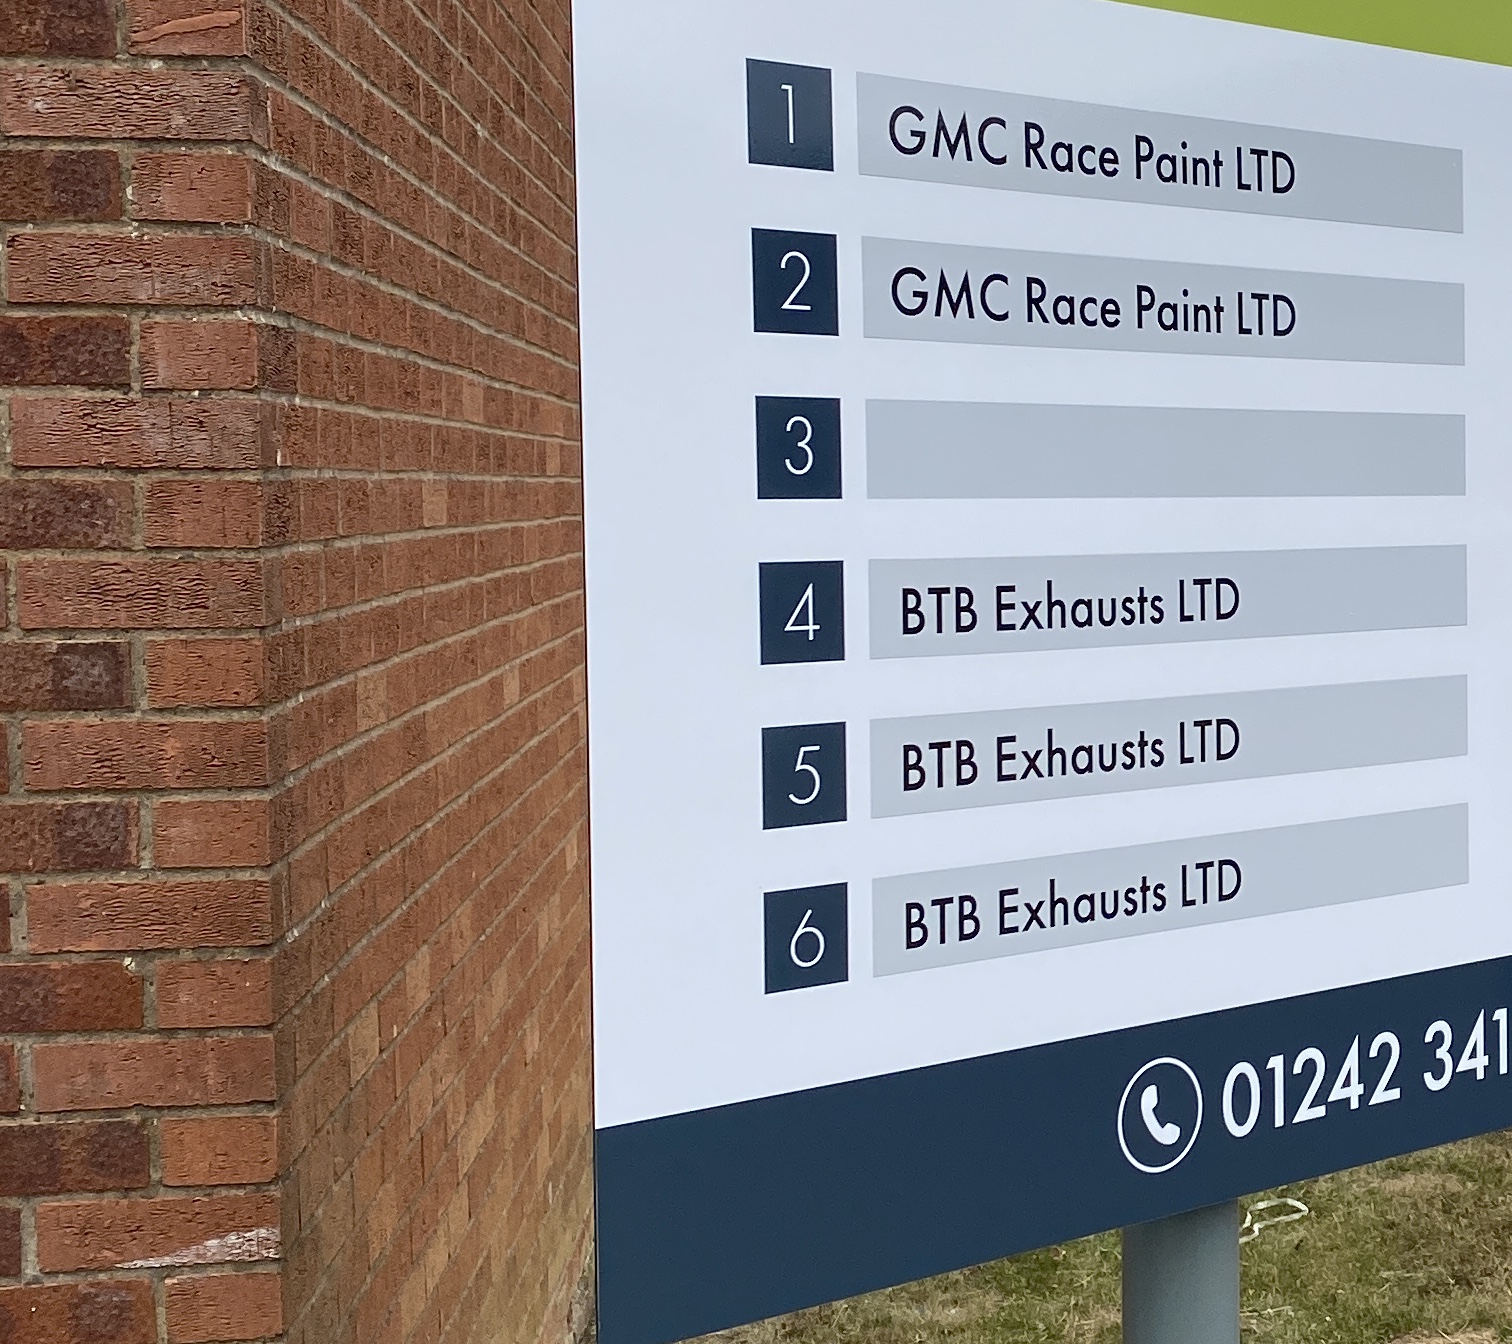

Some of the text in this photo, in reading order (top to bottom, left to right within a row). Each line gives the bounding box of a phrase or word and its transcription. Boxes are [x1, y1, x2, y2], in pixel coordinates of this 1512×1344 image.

[781, 84, 795, 144] 1
[889, 105, 1295, 194] GMC Race Paint LTD
[780, 251, 811, 311] 2
[891, 266, 1296, 336] GMC Race Paint LTD
[784, 416, 814, 475] 3
[784, 583, 820, 641] 4
[902, 577, 1240, 635] BTB Exhausts LTD
[788, 745, 821, 805] 5
[902, 718, 1240, 792] BTB Exhausts LTD
[905, 859, 1241, 950] BTB Exhausts LTD
[789, 909, 825, 968] 6
[1222, 1031, 1401, 1138] 01242
[1423, 1008, 1508, 1091] 341
